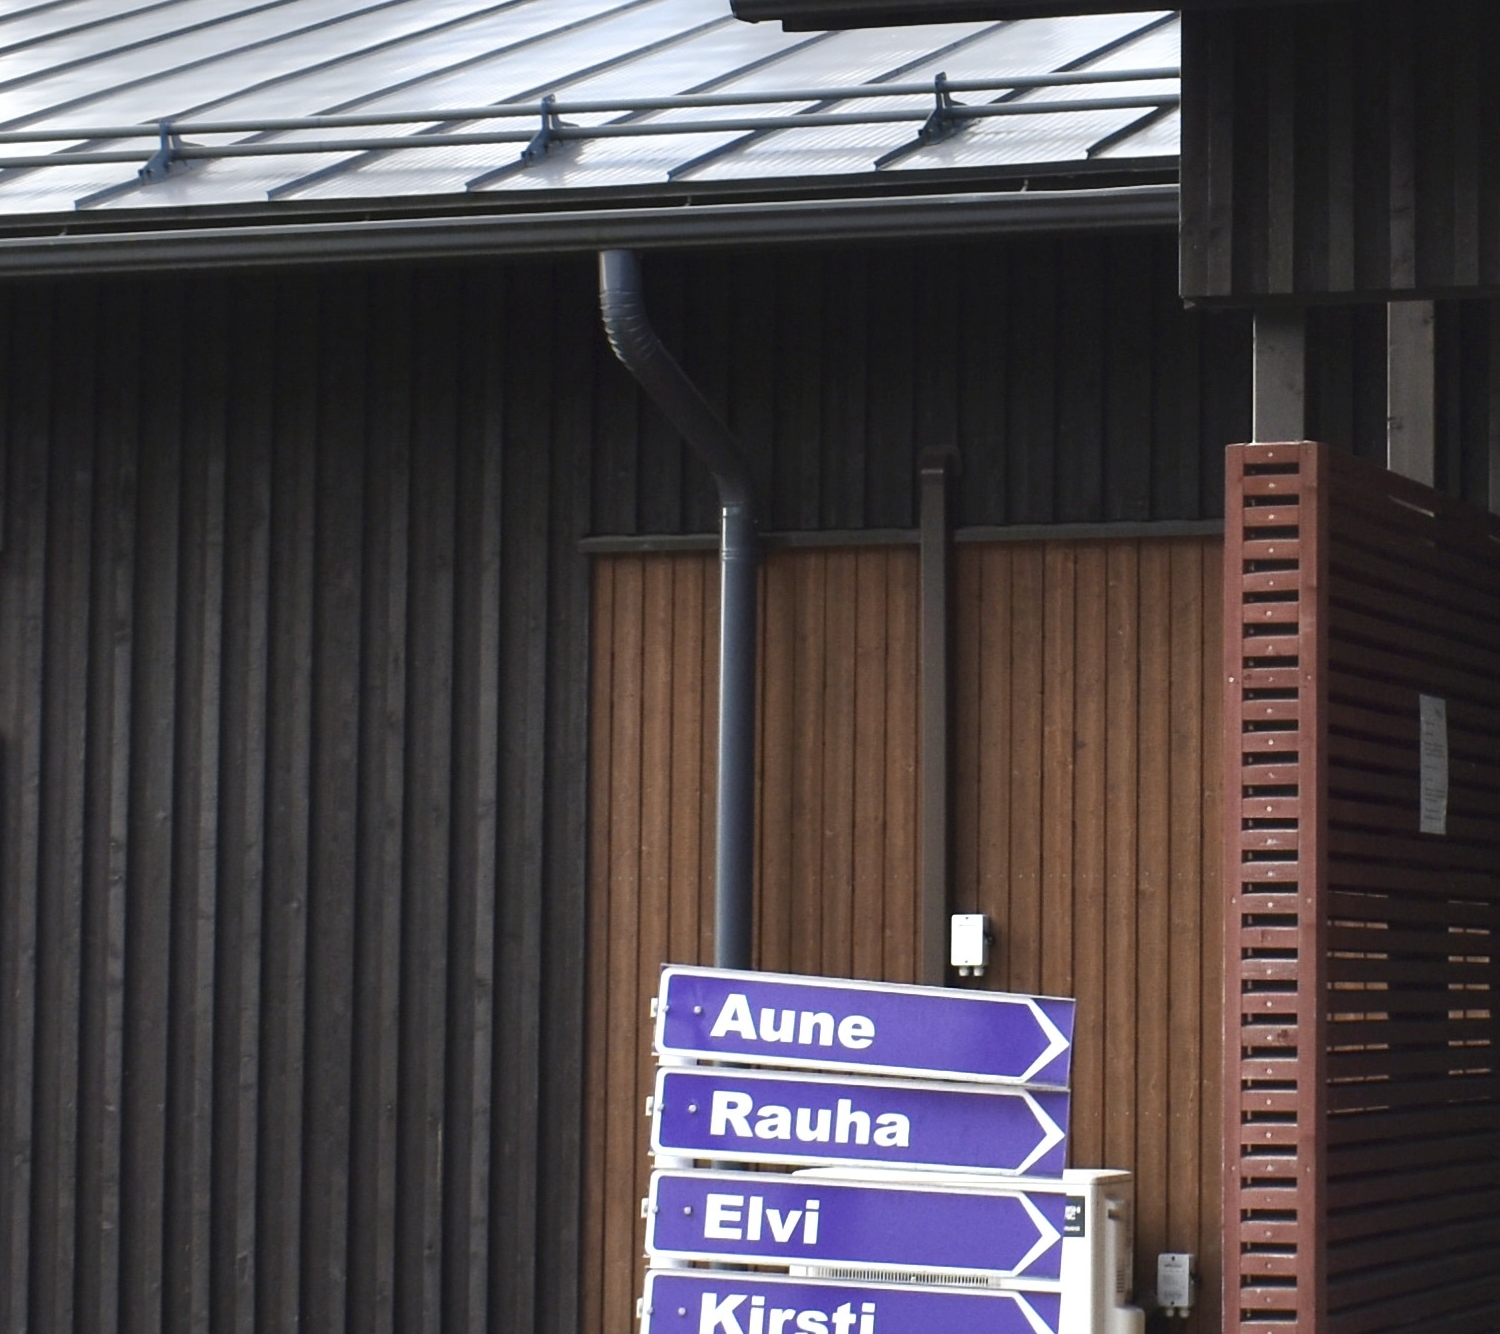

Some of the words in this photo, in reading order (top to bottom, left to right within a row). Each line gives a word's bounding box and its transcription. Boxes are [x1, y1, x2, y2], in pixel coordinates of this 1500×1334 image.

[710, 993, 876, 1049] Aune
[709, 1090, 911, 1147] Rauha
[704, 1194, 819, 1244] Elvi
